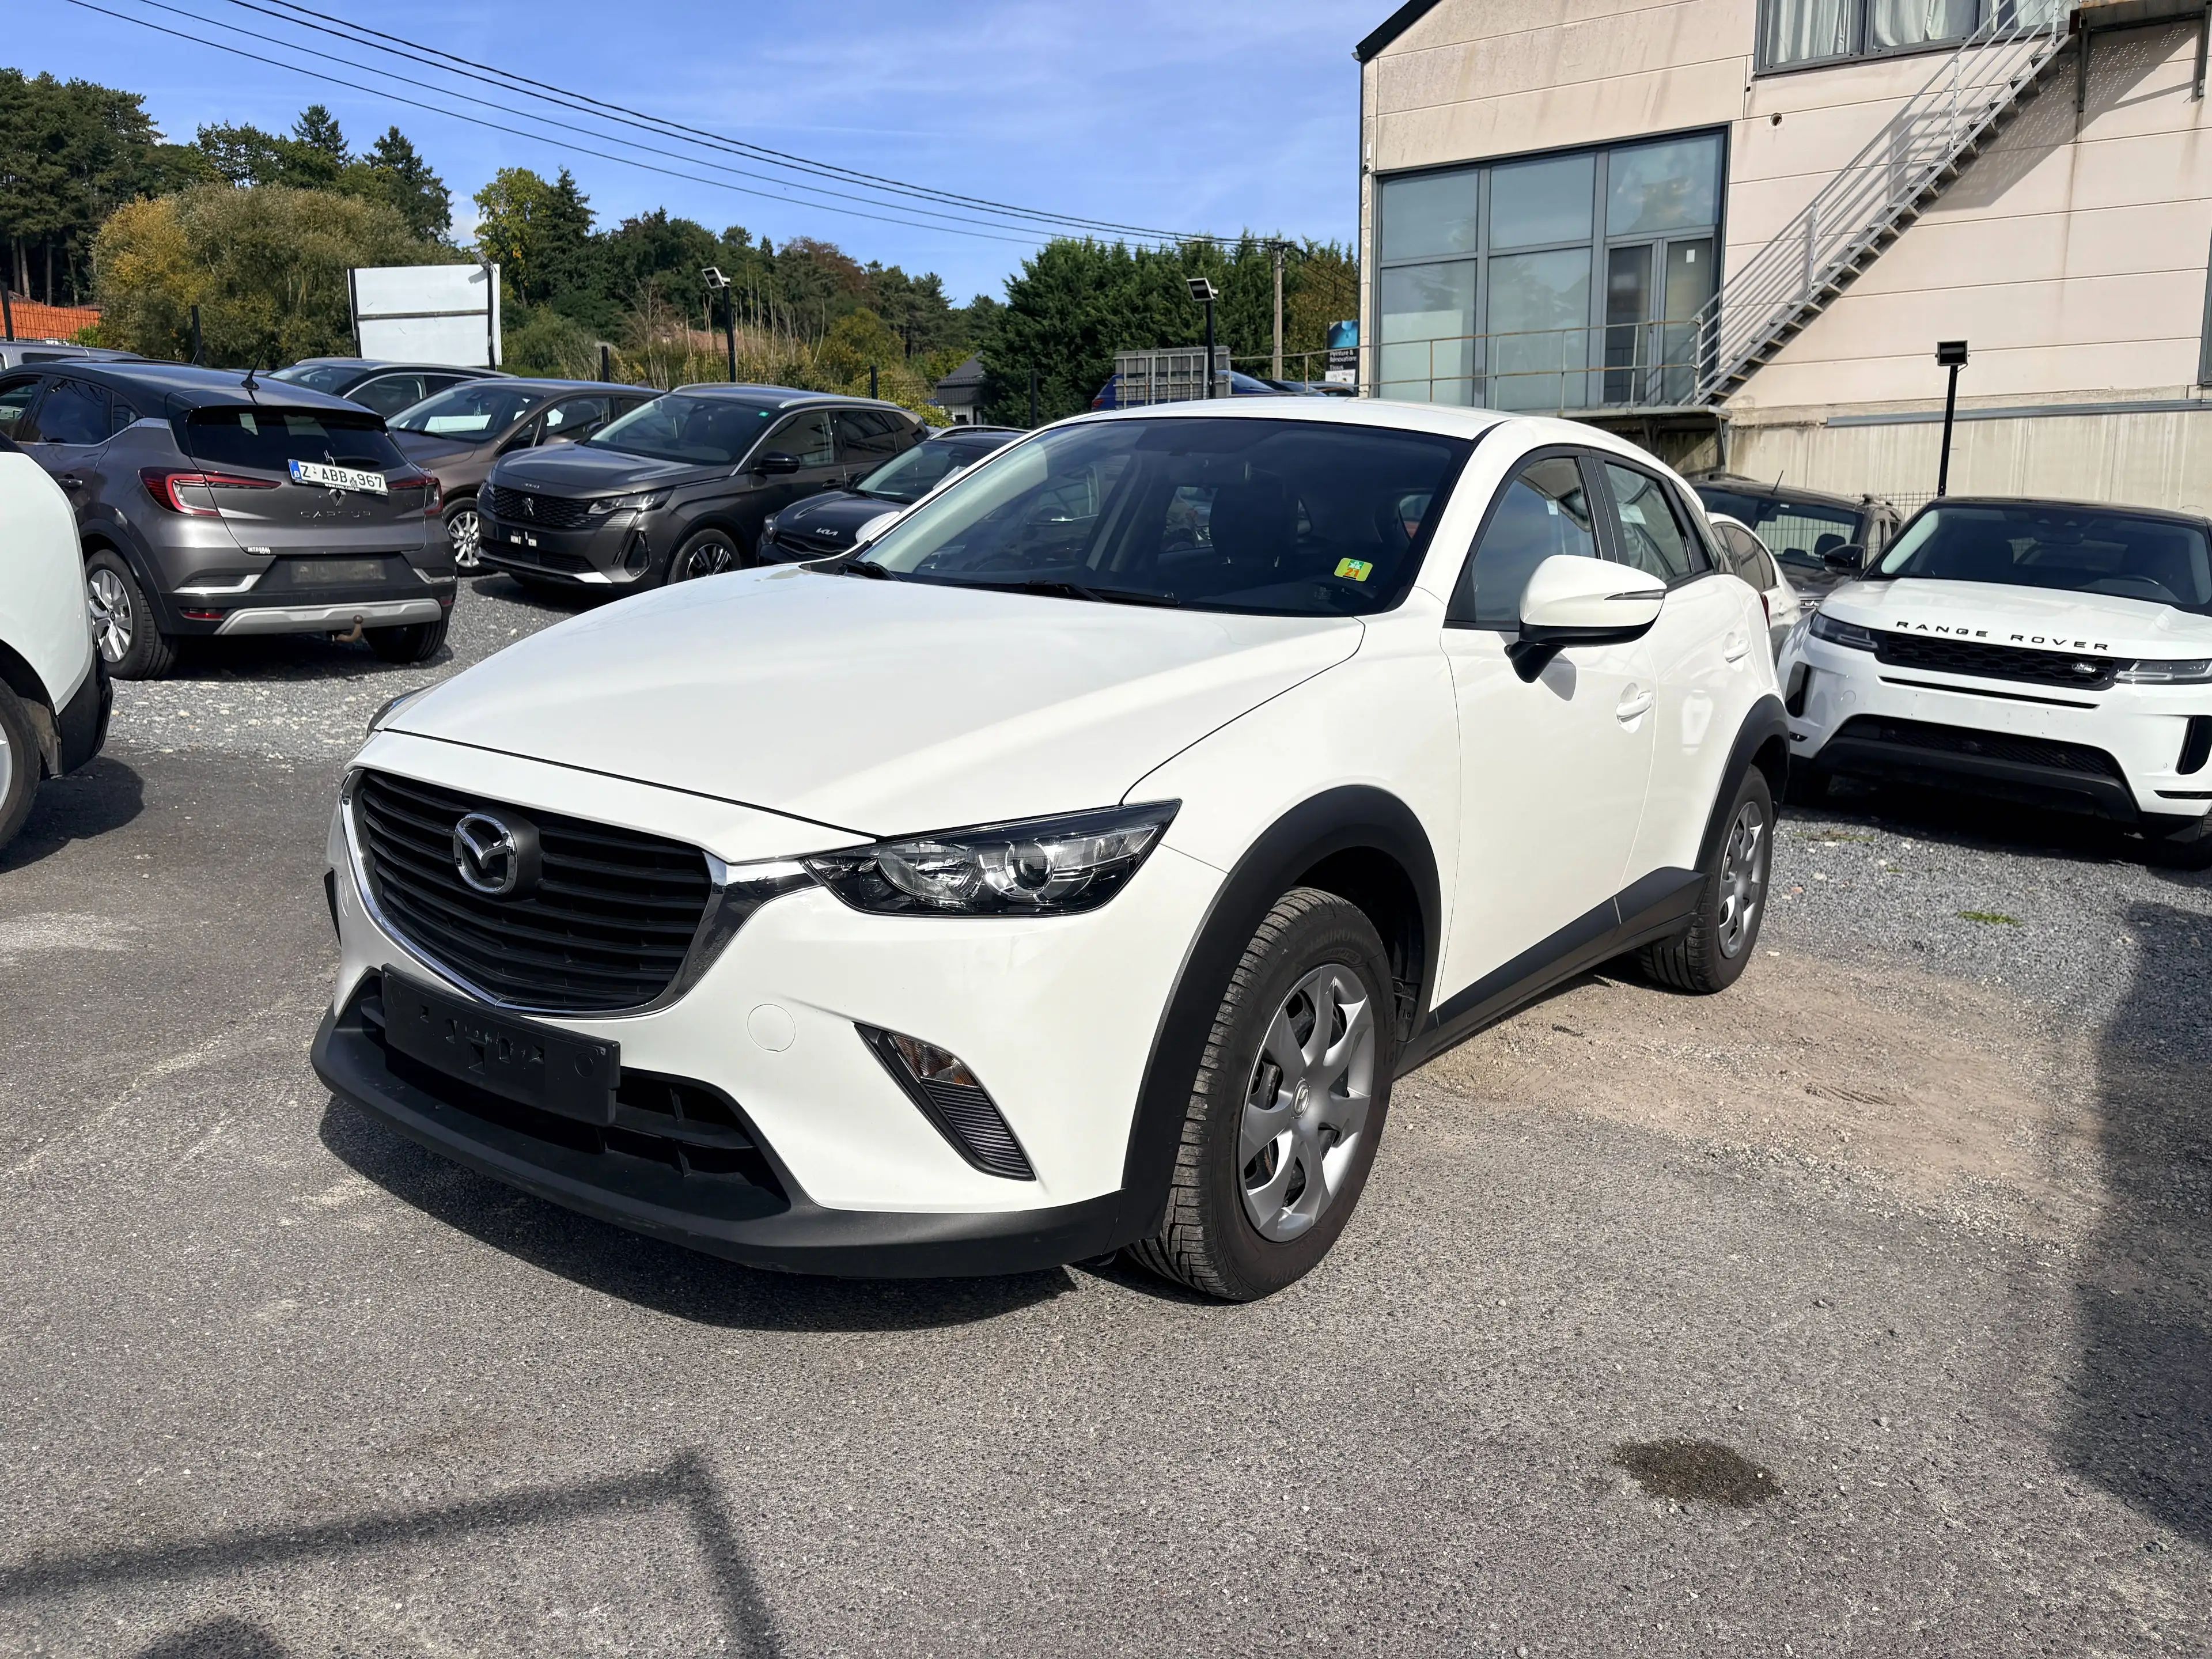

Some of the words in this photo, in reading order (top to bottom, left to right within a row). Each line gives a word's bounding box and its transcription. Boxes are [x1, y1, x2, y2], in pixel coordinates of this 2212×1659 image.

[300, 510, 371, 518] CAPTUR
[1344, 568, 1360, 577] 21
[1896, 621, 1988, 638] RANGE
[2010, 634, 2108, 651] ROVER
